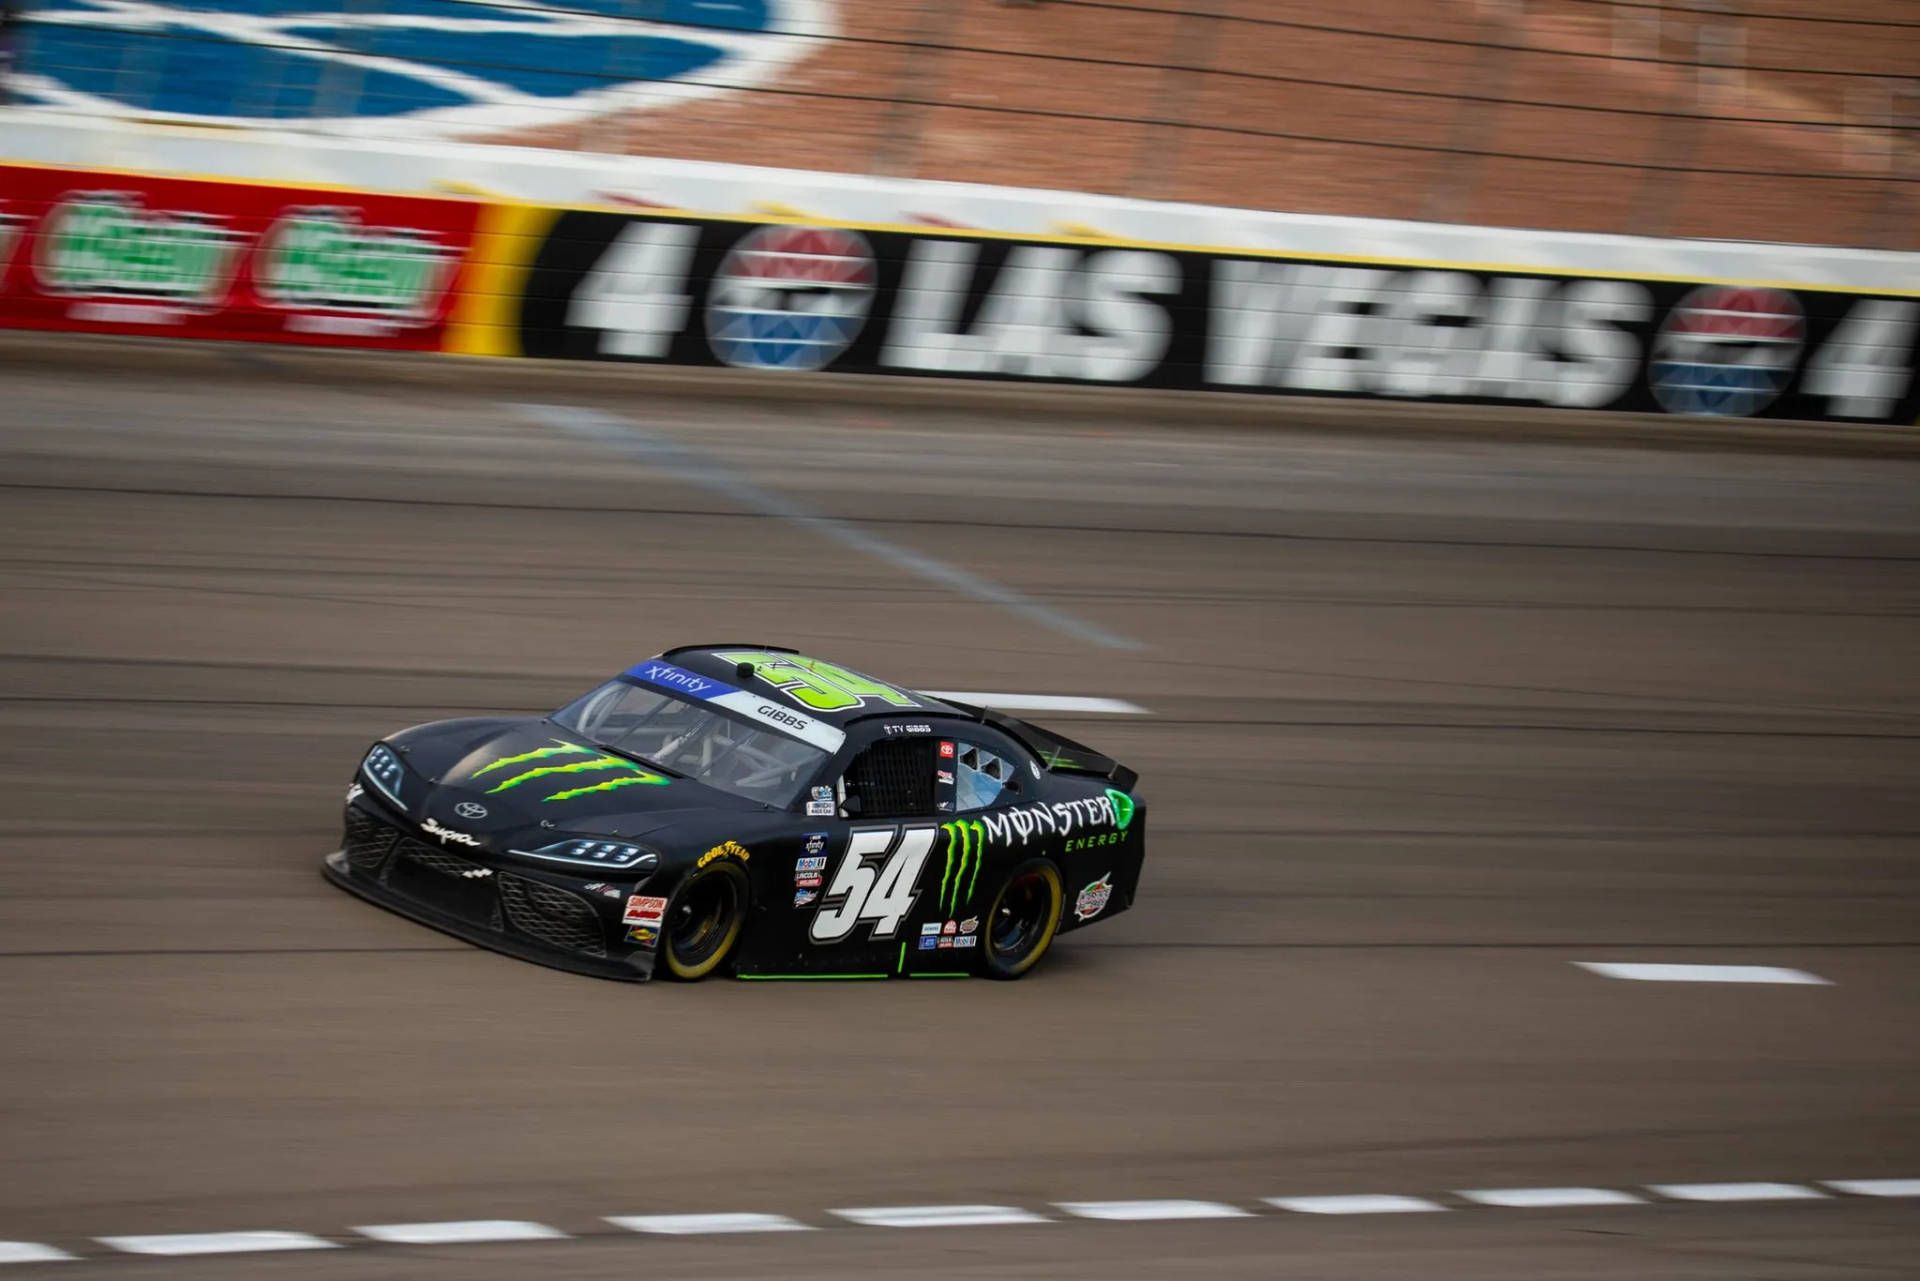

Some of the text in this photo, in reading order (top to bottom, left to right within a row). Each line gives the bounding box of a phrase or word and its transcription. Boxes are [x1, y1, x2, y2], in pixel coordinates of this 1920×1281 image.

[564, 221, 703, 358] 4
[877, 237, 1184, 382] LAS
[646, 665, 713, 693] xfinity
[757, 704, 809, 731] GIBBS
[981, 795, 1117, 848] MONSTER
[1064, 830, 1129, 853] ENERGY
[697, 840, 751, 868] GOODYEAR
[809, 825, 937, 943] 54
